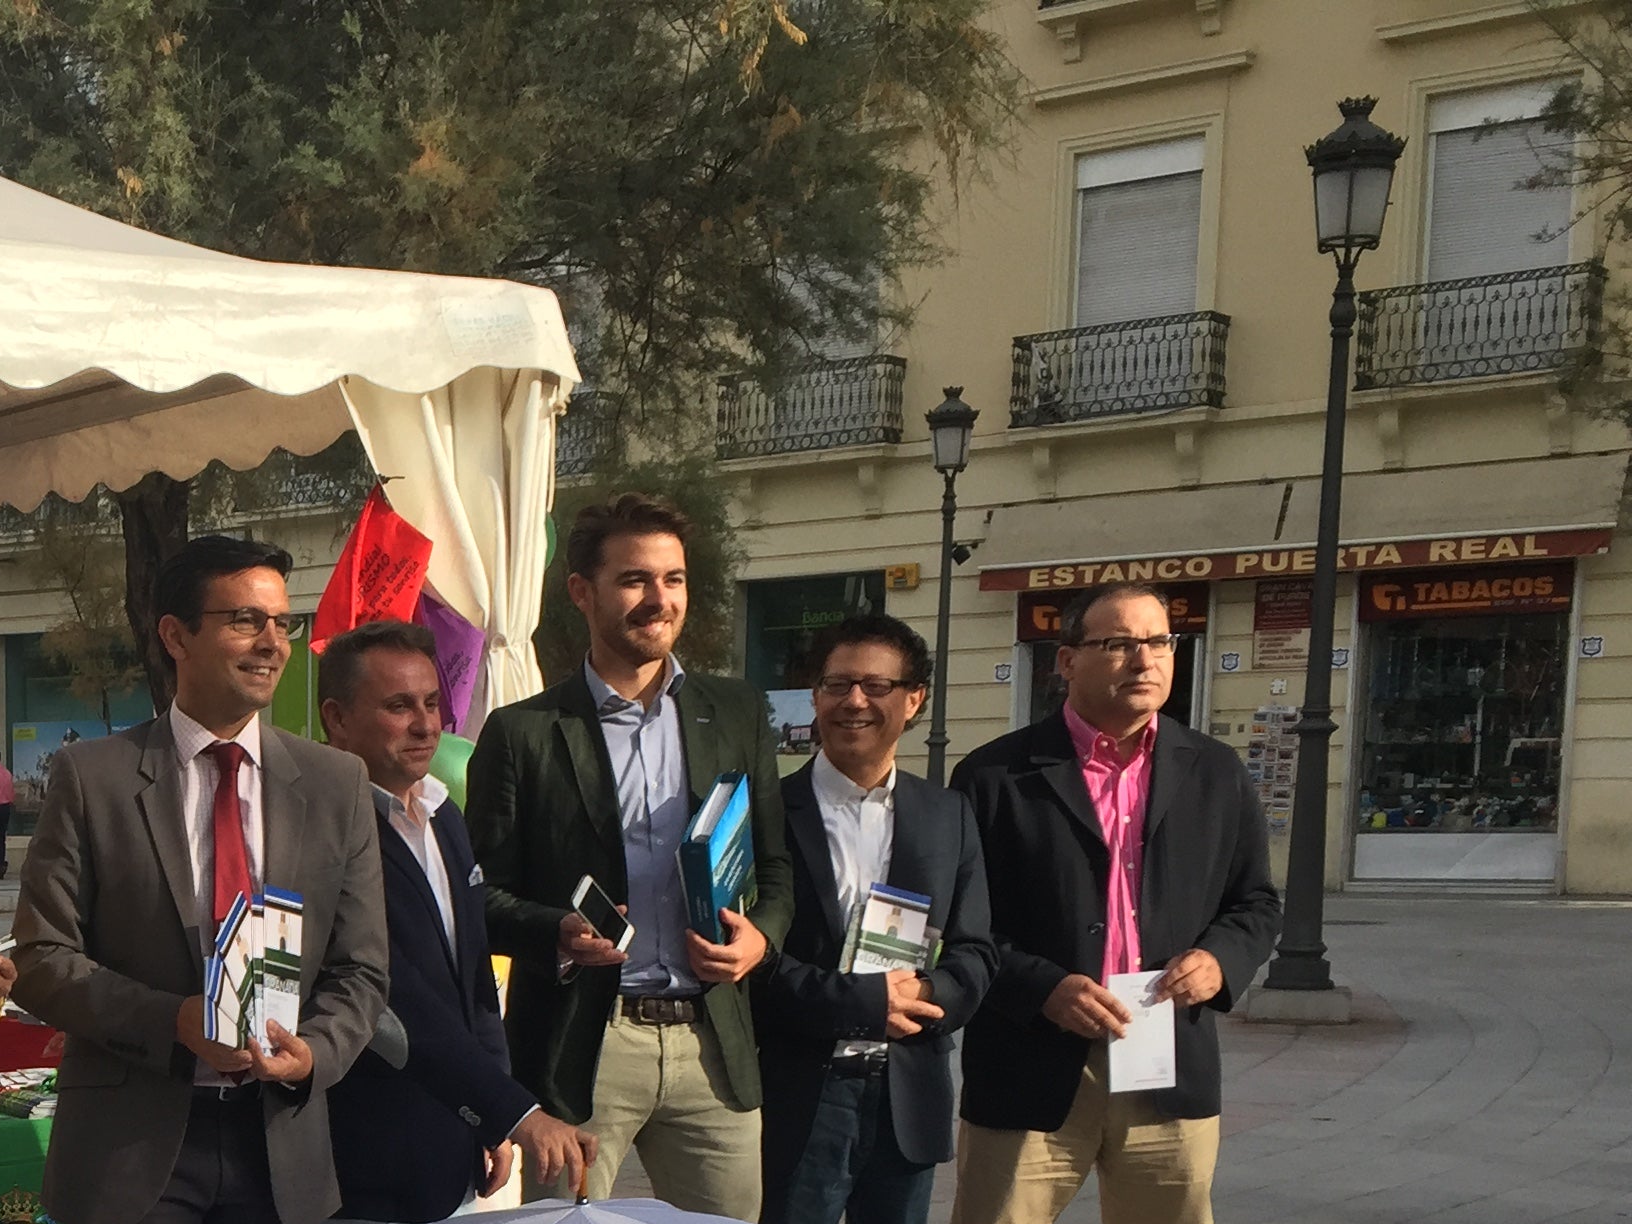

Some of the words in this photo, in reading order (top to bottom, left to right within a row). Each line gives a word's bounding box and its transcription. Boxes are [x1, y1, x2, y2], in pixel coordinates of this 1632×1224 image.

[1028, 556, 1213, 587] ESTANCO
[1429, 535, 1548, 562] REAL
[1413, 576, 1554, 602] TABACOS
[802, 611, 845, 624] Bankia
